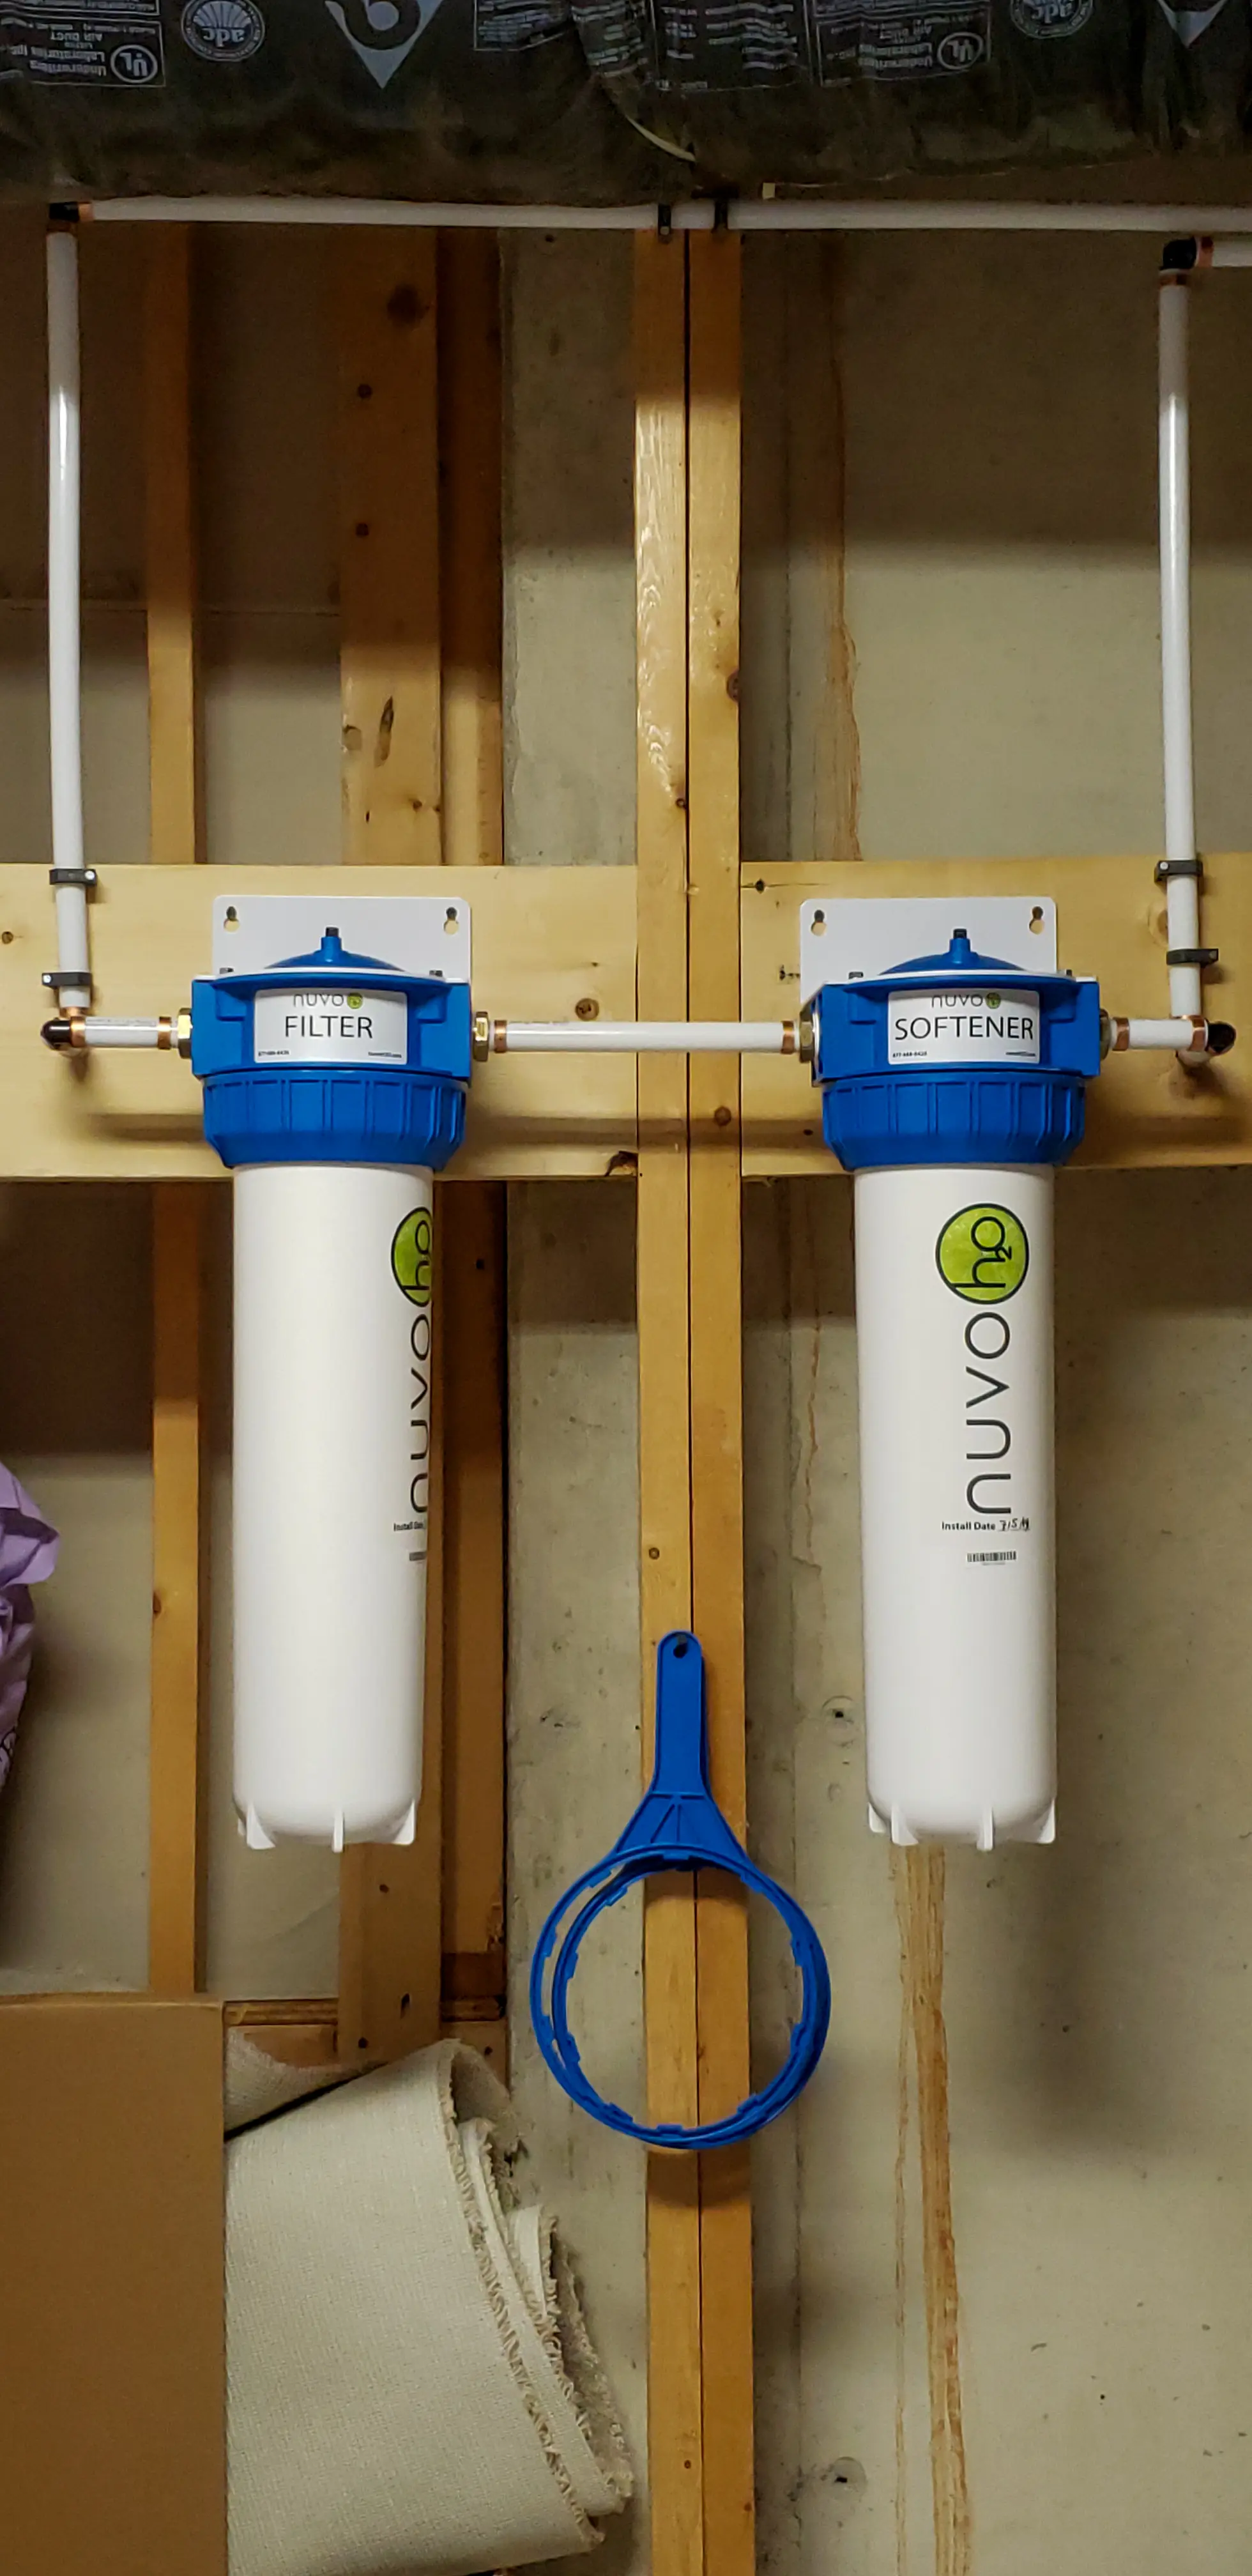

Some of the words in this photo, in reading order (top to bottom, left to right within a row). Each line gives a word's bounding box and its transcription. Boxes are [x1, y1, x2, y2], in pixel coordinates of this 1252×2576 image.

[50, 32, 79, 41] DUCT
[201, 28, 245, 47] adc
[293, 993, 344, 1007] nuvo
[931, 994, 983, 1008] nuvo
[285, 1015, 372, 1039] FILTER
[894, 1016, 1033, 1041] SOFTENER
[411, 1314, 430, 1514] nuvo
[964, 1312, 1011, 1514] nuvo
[942, 1521, 972, 1531] Install
[974, 1522, 996, 1530] Date
